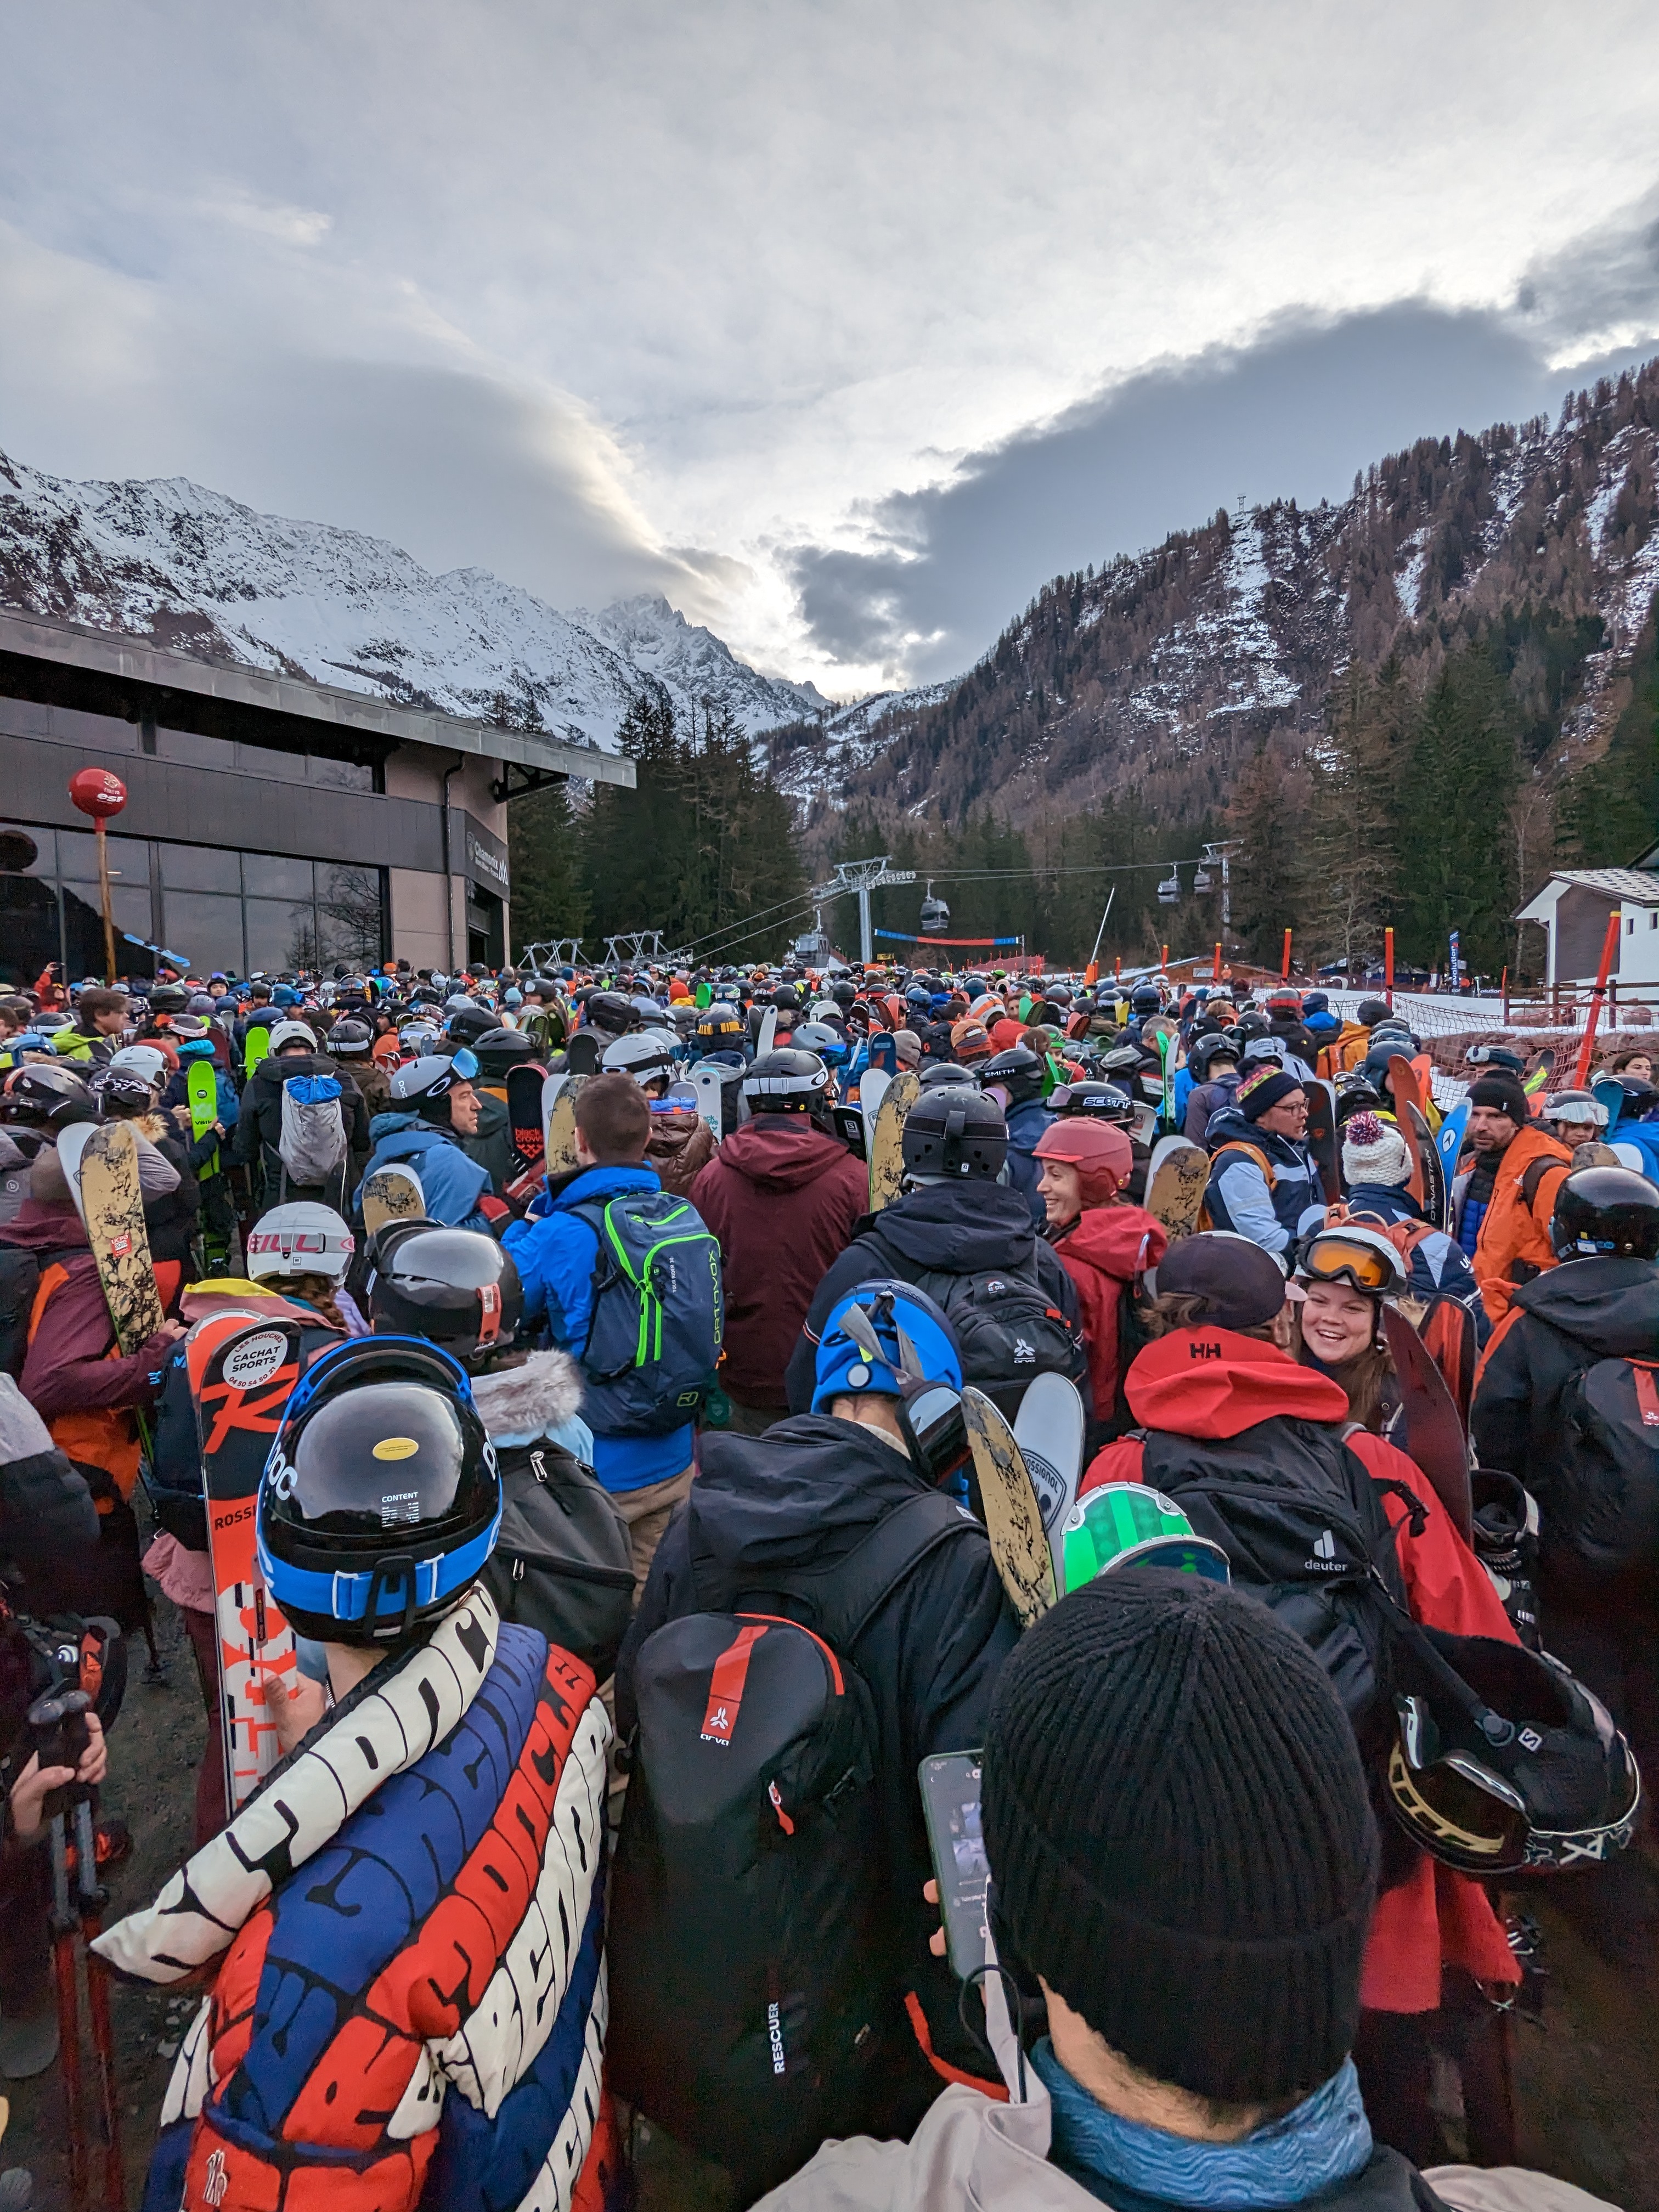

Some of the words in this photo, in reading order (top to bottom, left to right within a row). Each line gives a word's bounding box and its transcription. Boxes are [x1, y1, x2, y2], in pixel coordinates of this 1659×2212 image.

[97, 793, 123, 803] esf
[984, 1069, 1014, 1077] SMITH
[1083, 1096, 1131, 1109] SCOTT
[1425, 1148, 1436, 1222] DYNASTAR
[708, 1250, 720, 1344] ORTOVOX
[235, 1340, 250, 1353] LES
[252, 1333, 284, 1343] HOUCHES
[1189, 1343, 1221, 1359] HH
[233, 1346, 281, 1363] CACHAT
[232, 1356, 276, 1372] SPORTS
[259, 1374, 268, 1382] 50
[1026, 1458, 1058, 1494] OSSIGNOL
[381, 1491, 419, 1503] CONTENT
[1304, 1560, 1348, 1572] deuter
[701, 1734, 729, 1746] arva
[768, 2002, 785, 2074] RESCUER
